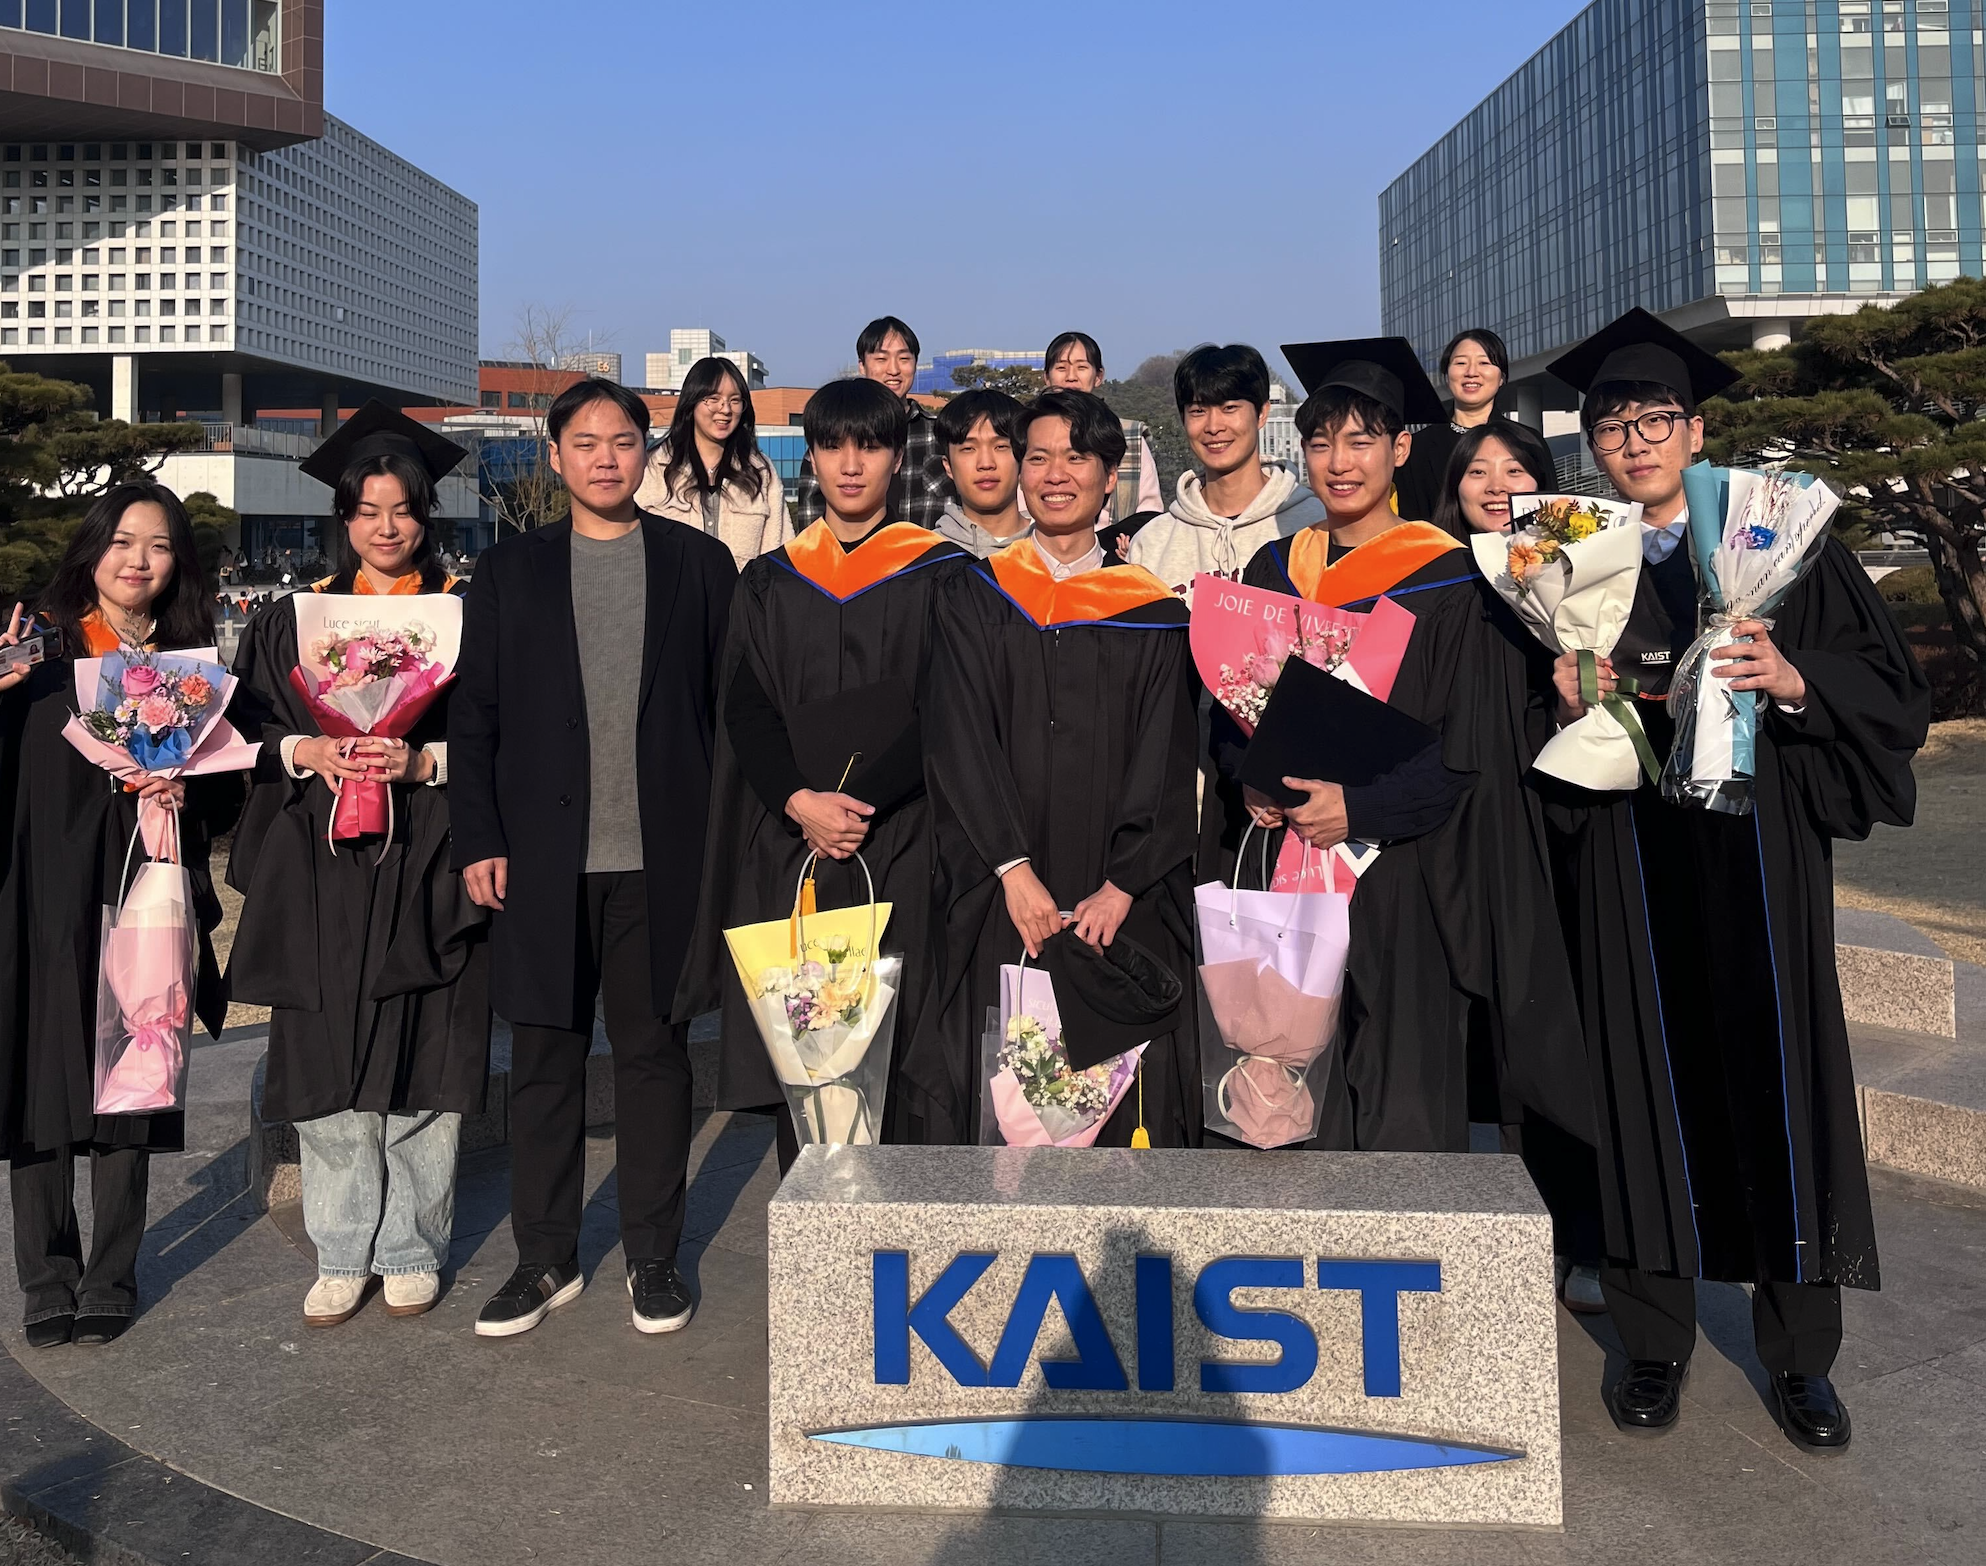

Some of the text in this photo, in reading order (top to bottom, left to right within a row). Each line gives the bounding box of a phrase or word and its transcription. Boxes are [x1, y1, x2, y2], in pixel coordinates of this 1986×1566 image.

[597, 361, 610, 373] E6
[1214, 592, 1254, 616] JOIE
[1263, 604, 1287, 624] DE
[323, 616, 349, 629] Luce
[1640, 651, 1671, 661] KAIST
[873, 1251, 1441, 1397] KAIST
